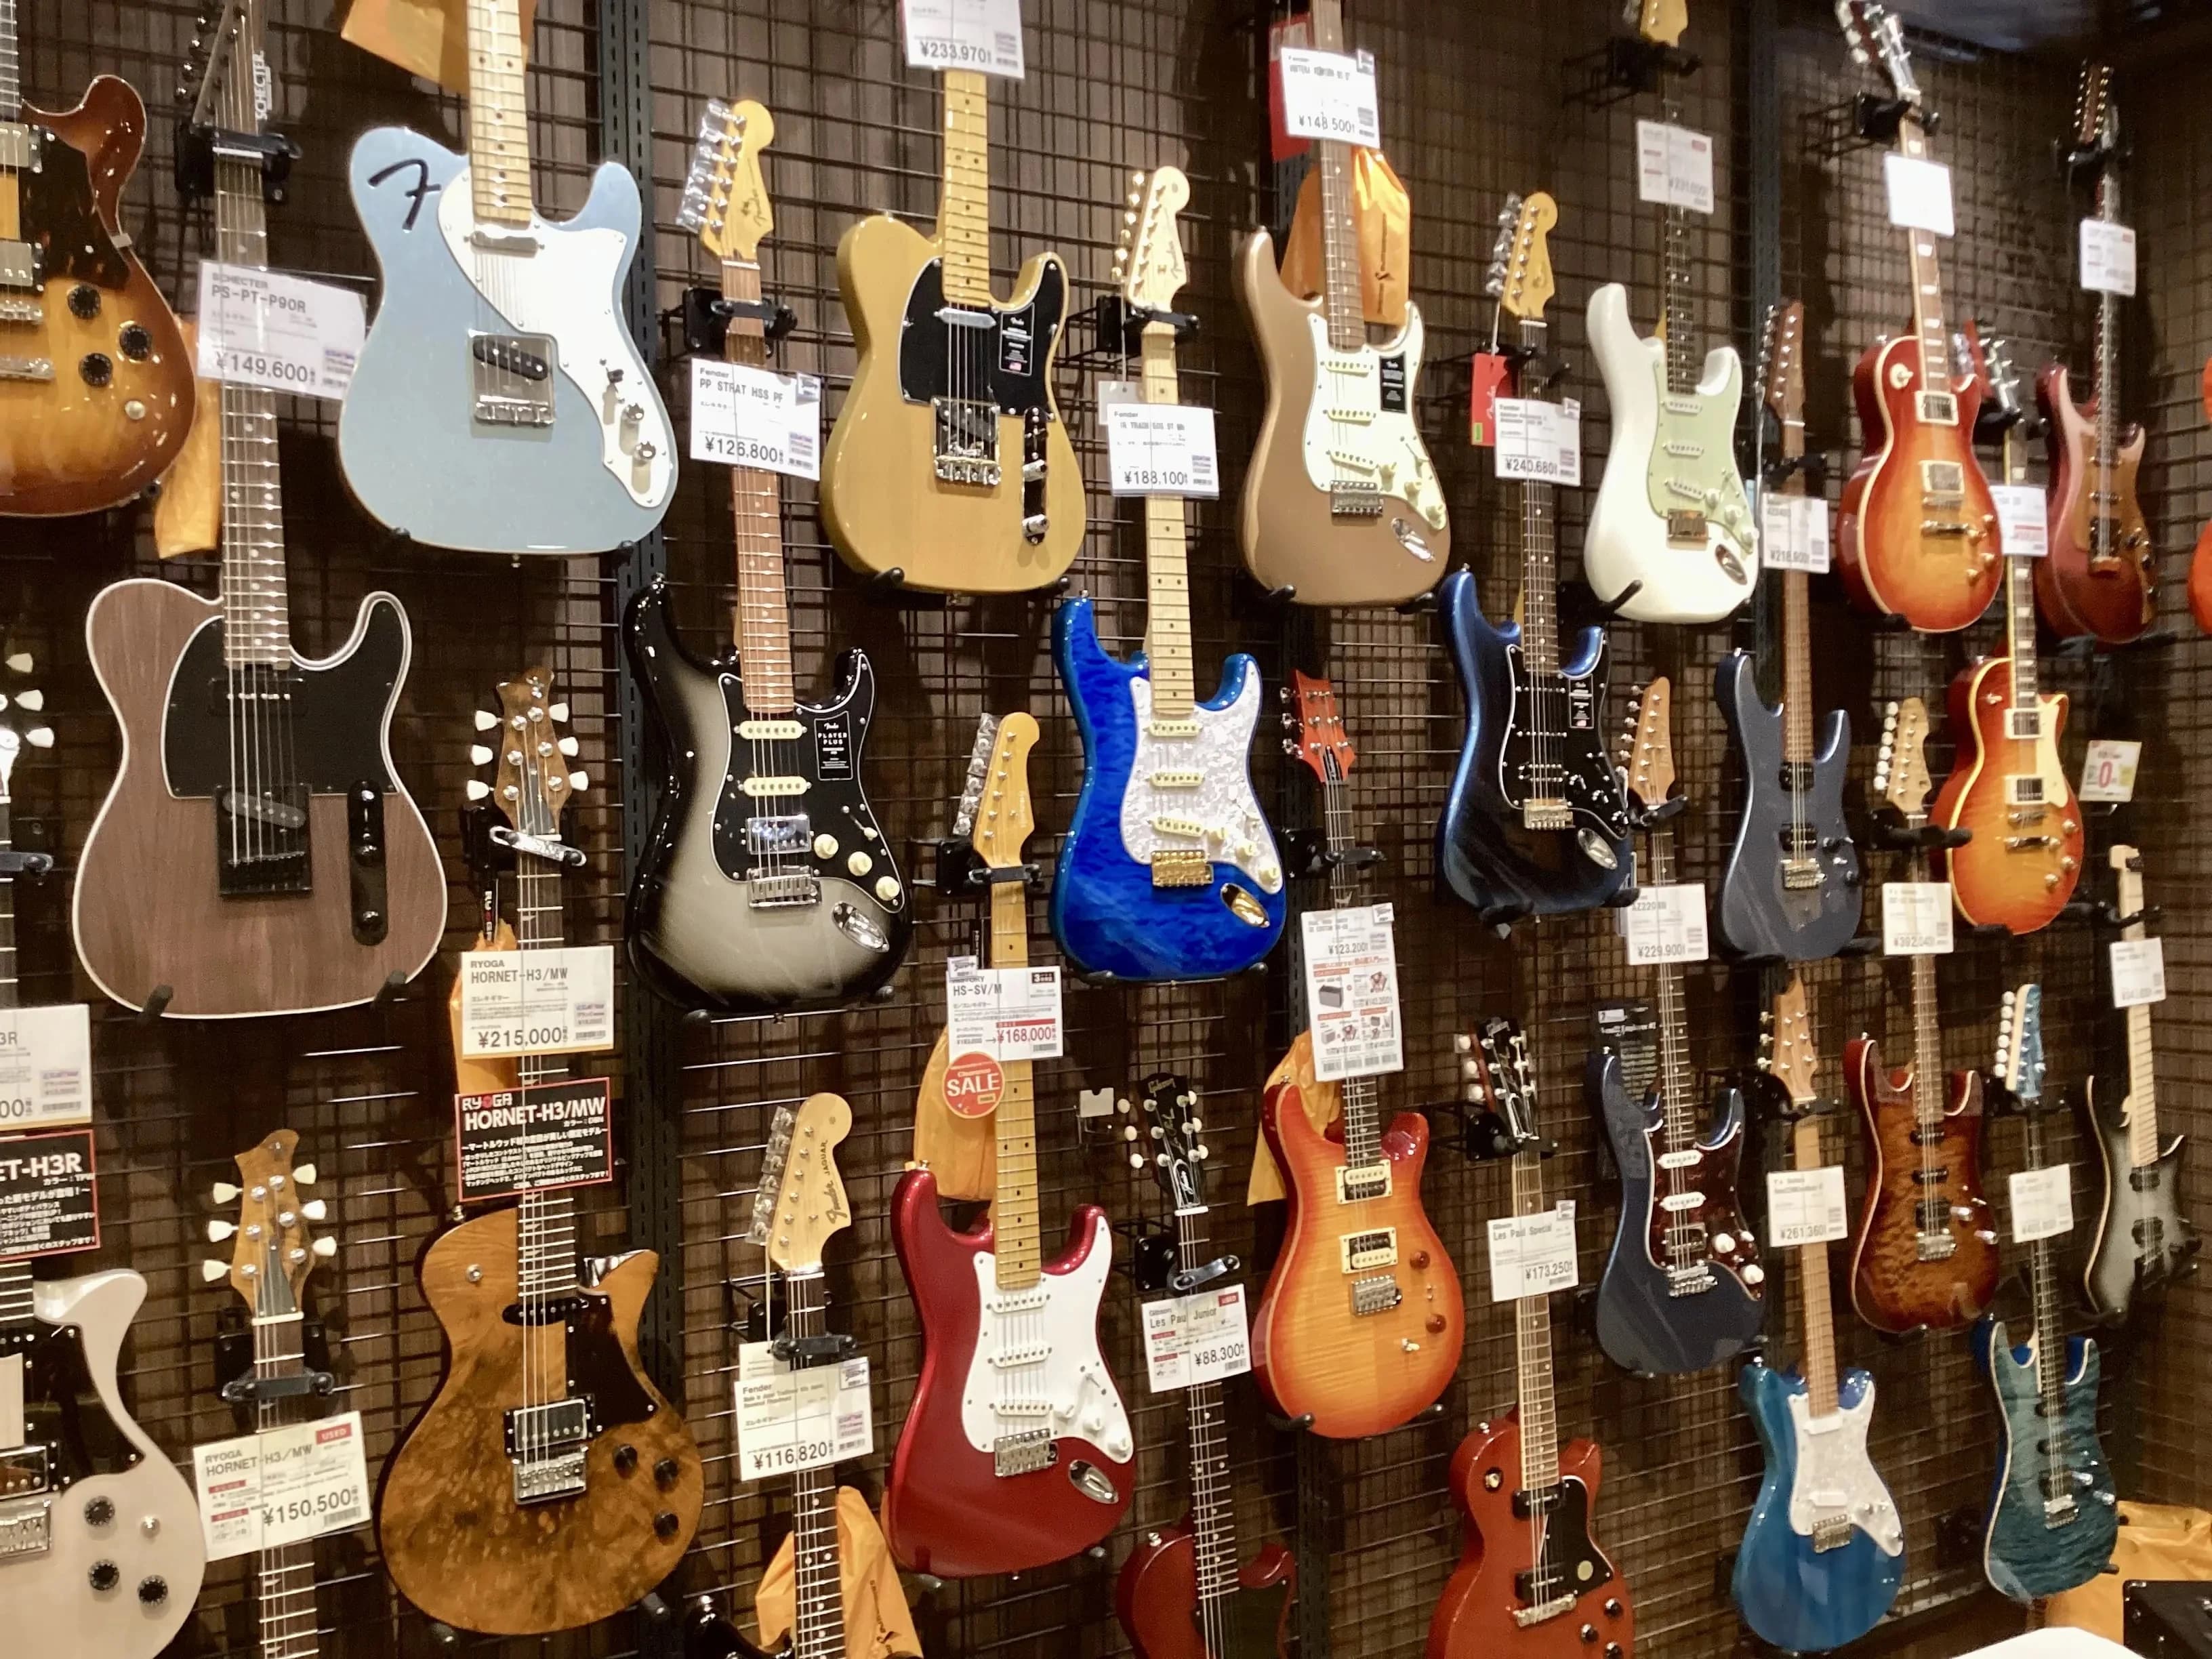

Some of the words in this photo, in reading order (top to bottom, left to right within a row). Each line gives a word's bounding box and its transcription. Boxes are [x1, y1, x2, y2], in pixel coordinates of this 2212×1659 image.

[1299, 115, 1351, 133] ¥148500
[212, 273, 268, 289] SCHECTER
[211, 284, 306, 313] PS-PT-P90R
[216, 351, 308, 383] ¥149,600
[700, 367, 730, 377] Fender
[699, 378, 712, 388] PP
[717, 382, 747, 395] STRAT
[752, 387, 769, 400] HSS
[705, 436, 778, 462] ¥126,800
[1124, 470, 1184, 485] ¥188,100
[470, 960, 504, 968] RYOGA
[471, 968, 568, 984] HORNET-H3/MW
[954, 984, 1002, 996] HS-SV/M
[478, 1027, 562, 1048] ¥215,000
[998, 1027, 1052, 1044] ¥168,000
[947, 1073, 1001, 1097] SALE
[462, 1092, 513, 1111] RYOGA
[464, 1097, 606, 1131] HORNET-H3/MW
[0, 1152, 83, 1181] ET-H3R
[820, 1139, 830, 1176] JAGUAR
[1493, 1231, 1507, 1241] Les
[1525, 1261, 1570, 1281] ¥173,250
[1150, 1317, 1166, 1328] Les
[1170, 1314, 1188, 1325] Pau
[1193, 1307, 1218, 1320] Junior
[1195, 1343, 1241, 1366] ¥88,300
[742, 1383, 772, 1394] Fender
[321, 1429, 347, 1441] USED
[205, 1449, 243, 1463] RYOGA
[206, 1444, 313, 1477] HORNET-H3/MW
[754, 1441, 827, 1470] ¥116,820
[262, 1488, 352, 1526] ¥150,500
